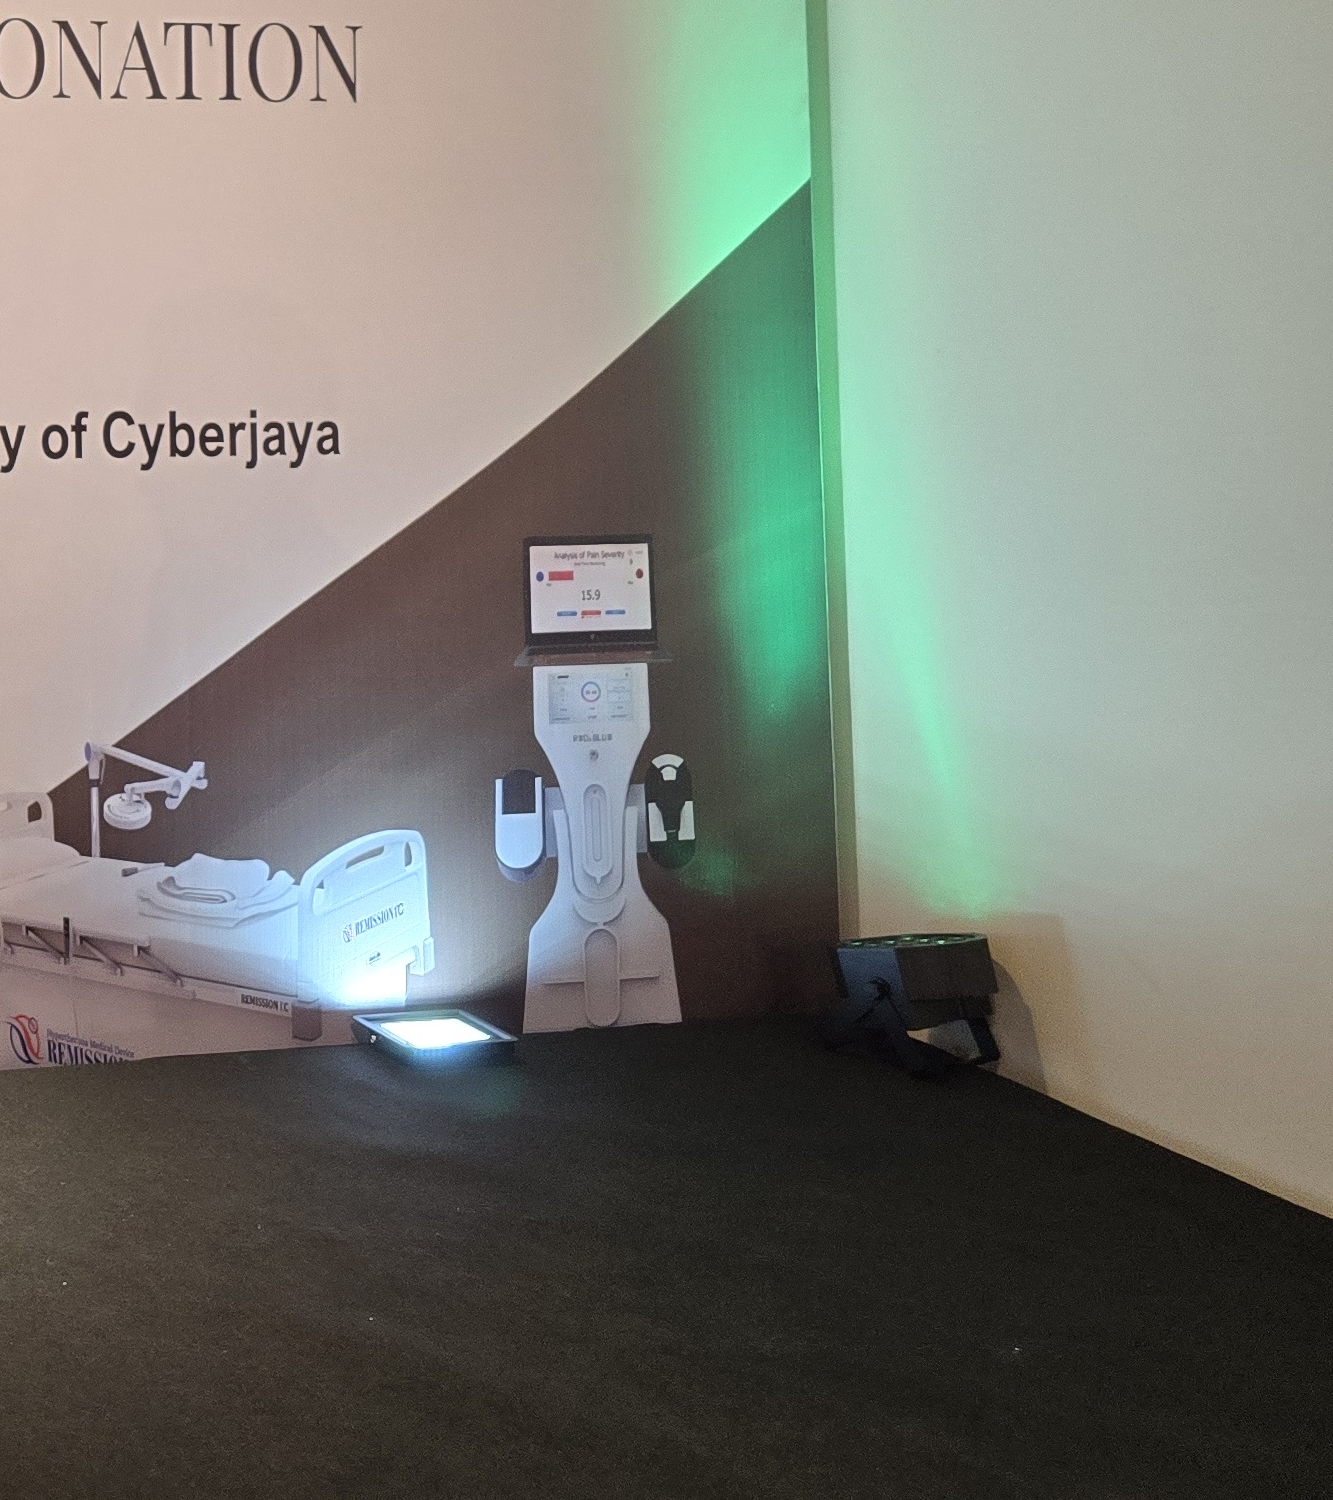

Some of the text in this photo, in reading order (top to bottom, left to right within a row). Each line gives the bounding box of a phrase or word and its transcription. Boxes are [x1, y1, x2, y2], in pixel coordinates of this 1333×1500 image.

[41, 410, 90, 461] of
[102, 409, 341, 472] Cyberjaya
[581, 588, 601, 601] 15.9
[240, 993, 279, 1011] REMISSION
